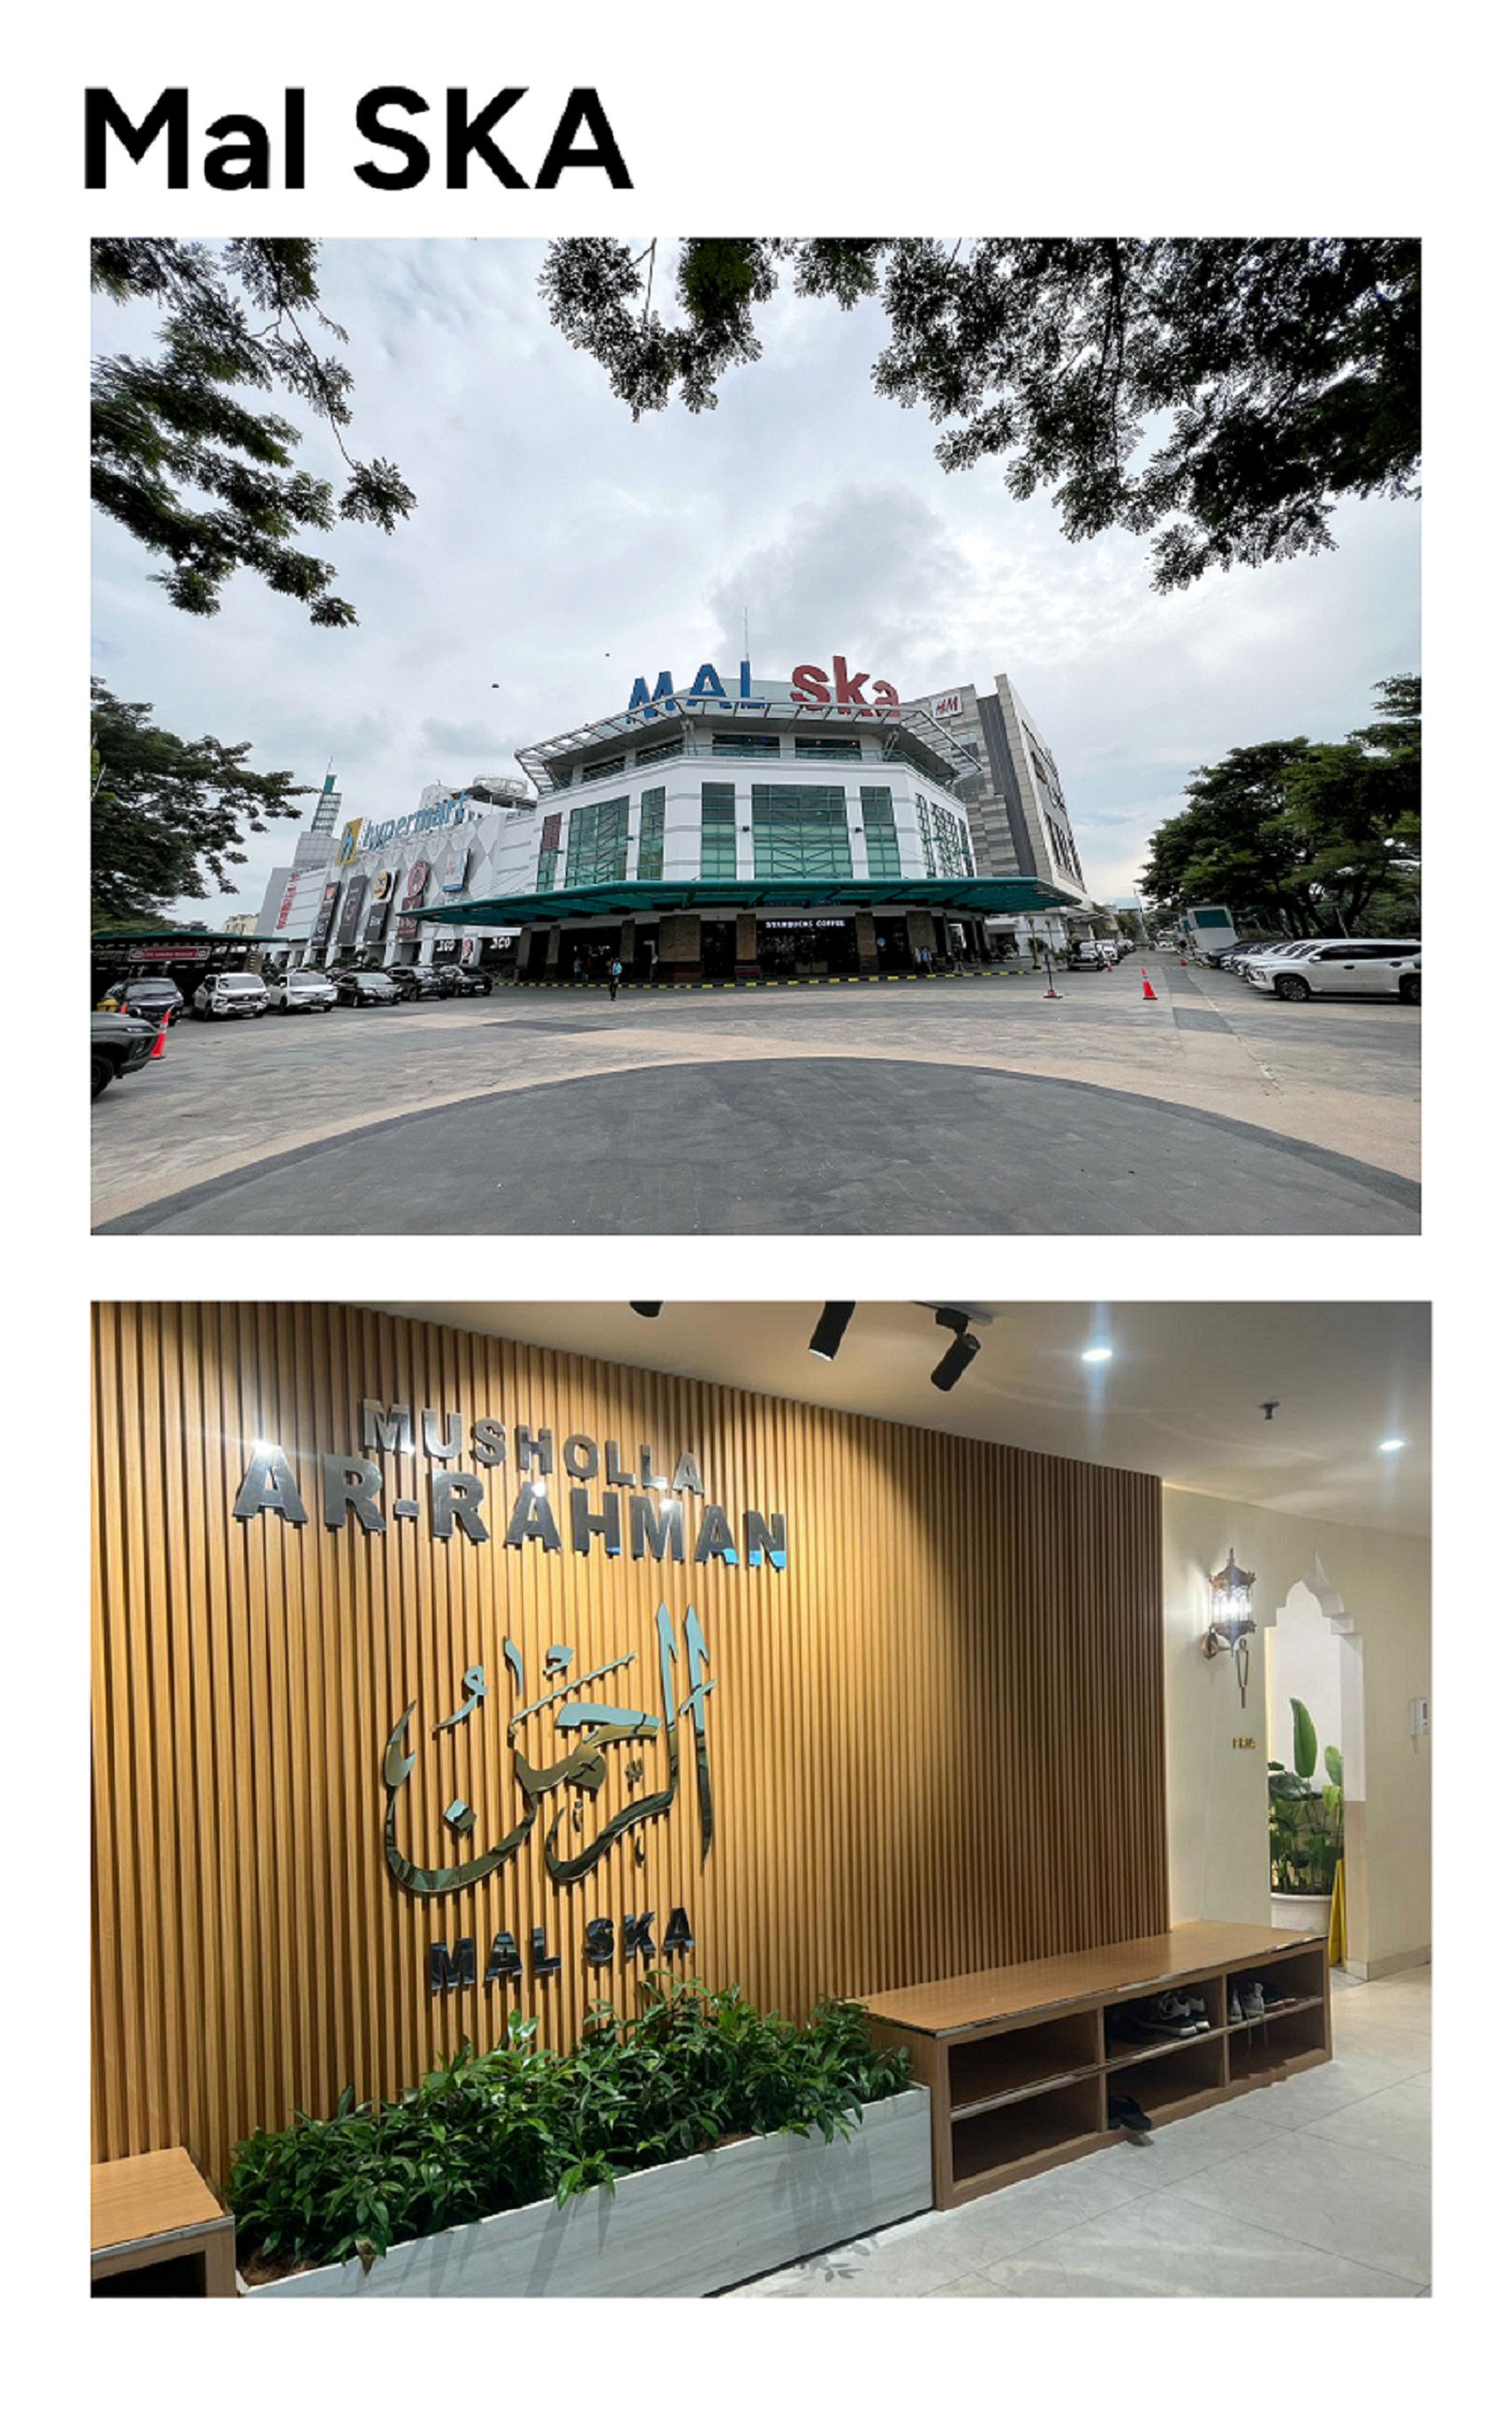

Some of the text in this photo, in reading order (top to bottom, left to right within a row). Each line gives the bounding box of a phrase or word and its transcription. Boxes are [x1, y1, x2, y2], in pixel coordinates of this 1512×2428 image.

[626, 661, 765, 724] MAL
[362, 791, 469, 850] hypermart
[362, 1398, 704, 1495] MUSHOLLA
[232, 1442, 787, 1571] AR-RAHMAN
[430, 1908, 695, 1990] MAL SKA
